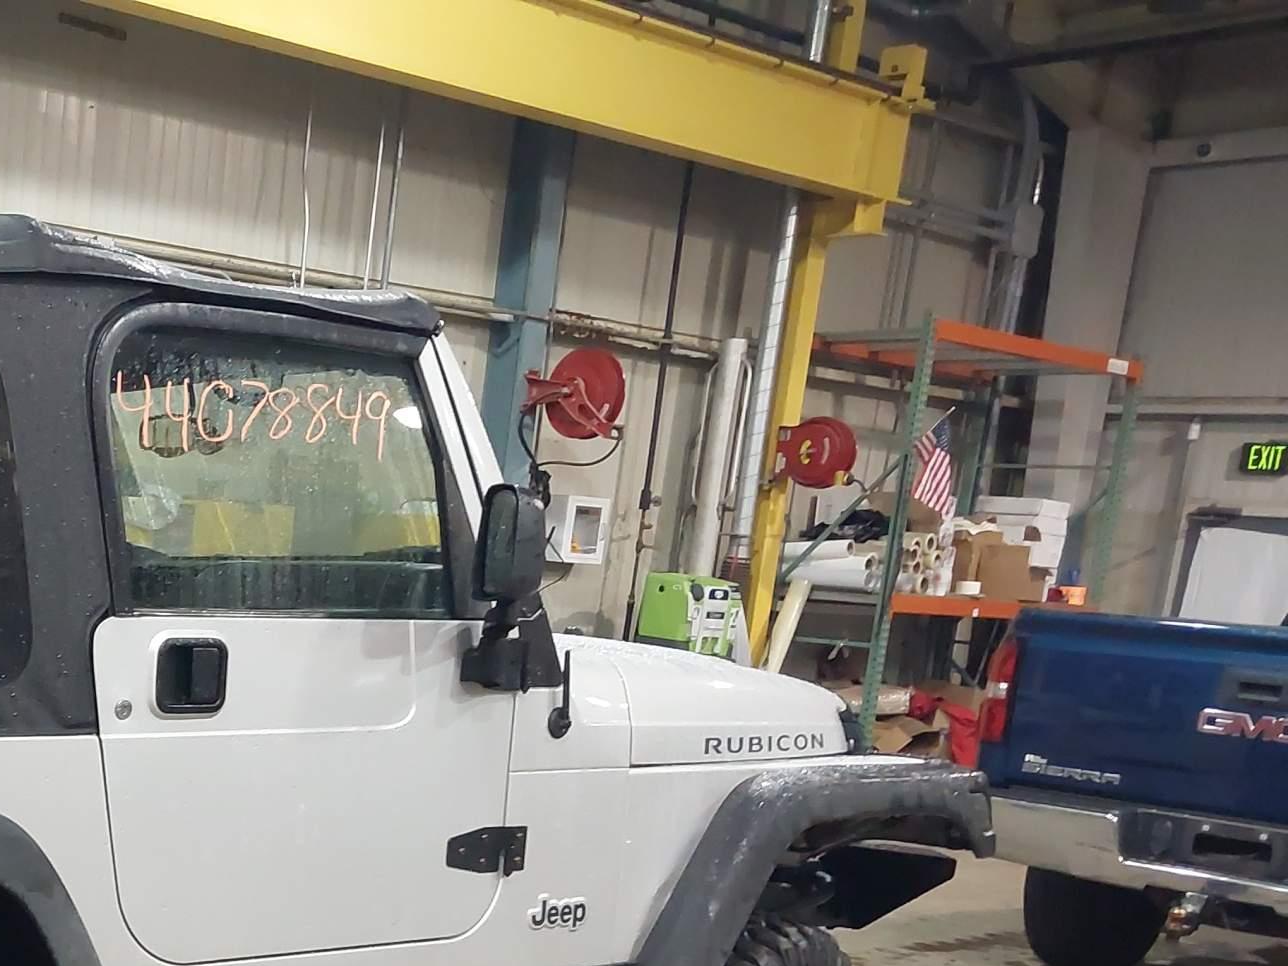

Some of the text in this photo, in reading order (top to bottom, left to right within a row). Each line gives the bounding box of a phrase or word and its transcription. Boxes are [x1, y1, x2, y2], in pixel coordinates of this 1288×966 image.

[1247, 445, 1287, 471] EXIT
[704, 733, 824, 755] RUBICON
[531, 898, 587, 928] Jeep
